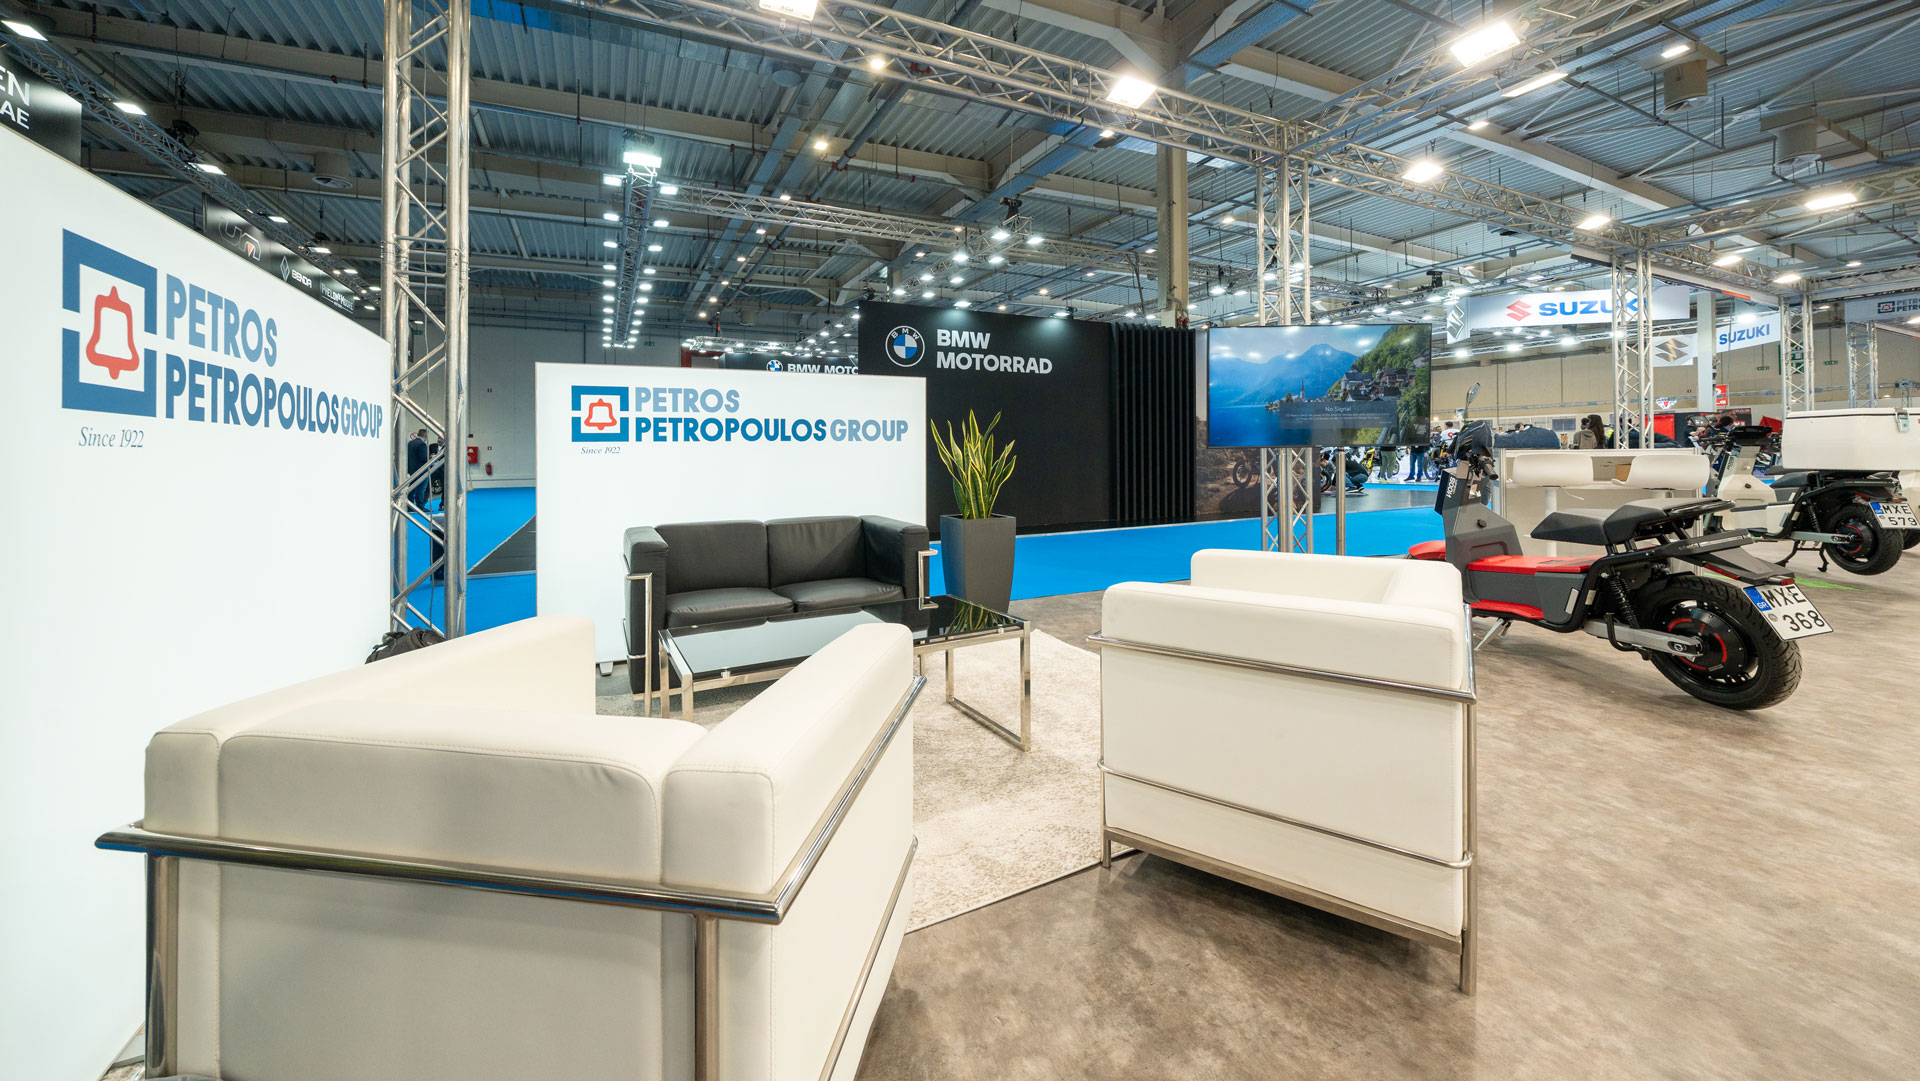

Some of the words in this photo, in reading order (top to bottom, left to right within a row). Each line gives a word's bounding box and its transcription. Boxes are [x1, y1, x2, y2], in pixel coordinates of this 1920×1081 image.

[0, 100, 30, 130] AE
[1896, 298, 1920, 306] PETR
[1896, 304, 1920, 313] PETR
[166, 273, 278, 368] PETROS
[936, 329, 991, 349] BMW
[1719, 323, 1770, 345] SUZUKI
[787, 363, 821, 373] BMW
[936, 351, 1053, 374] MOTORRAD
[166, 353, 339, 435] PETROPOULOS
[340, 396, 383, 439] GROUP
[635, 386, 740, 413] PETROS
[1334, 406, 1352, 414] Signal
[78, 426, 116, 448] Since
[119, 429, 145, 448] 1922
[635, 417, 827, 442] PETROPOULOS
[830, 418, 909, 442] GROUP
[580, 446, 602, 454] Since
[604, 446, 621, 454] 1922
[1882, 505, 1912, 514] MXE
[1888, 516, 1918, 526] 579
[1757, 601, 1769, 609] GR
[1761, 585, 1807, 608] MXE
[1782, 609, 1825, 632] 368
